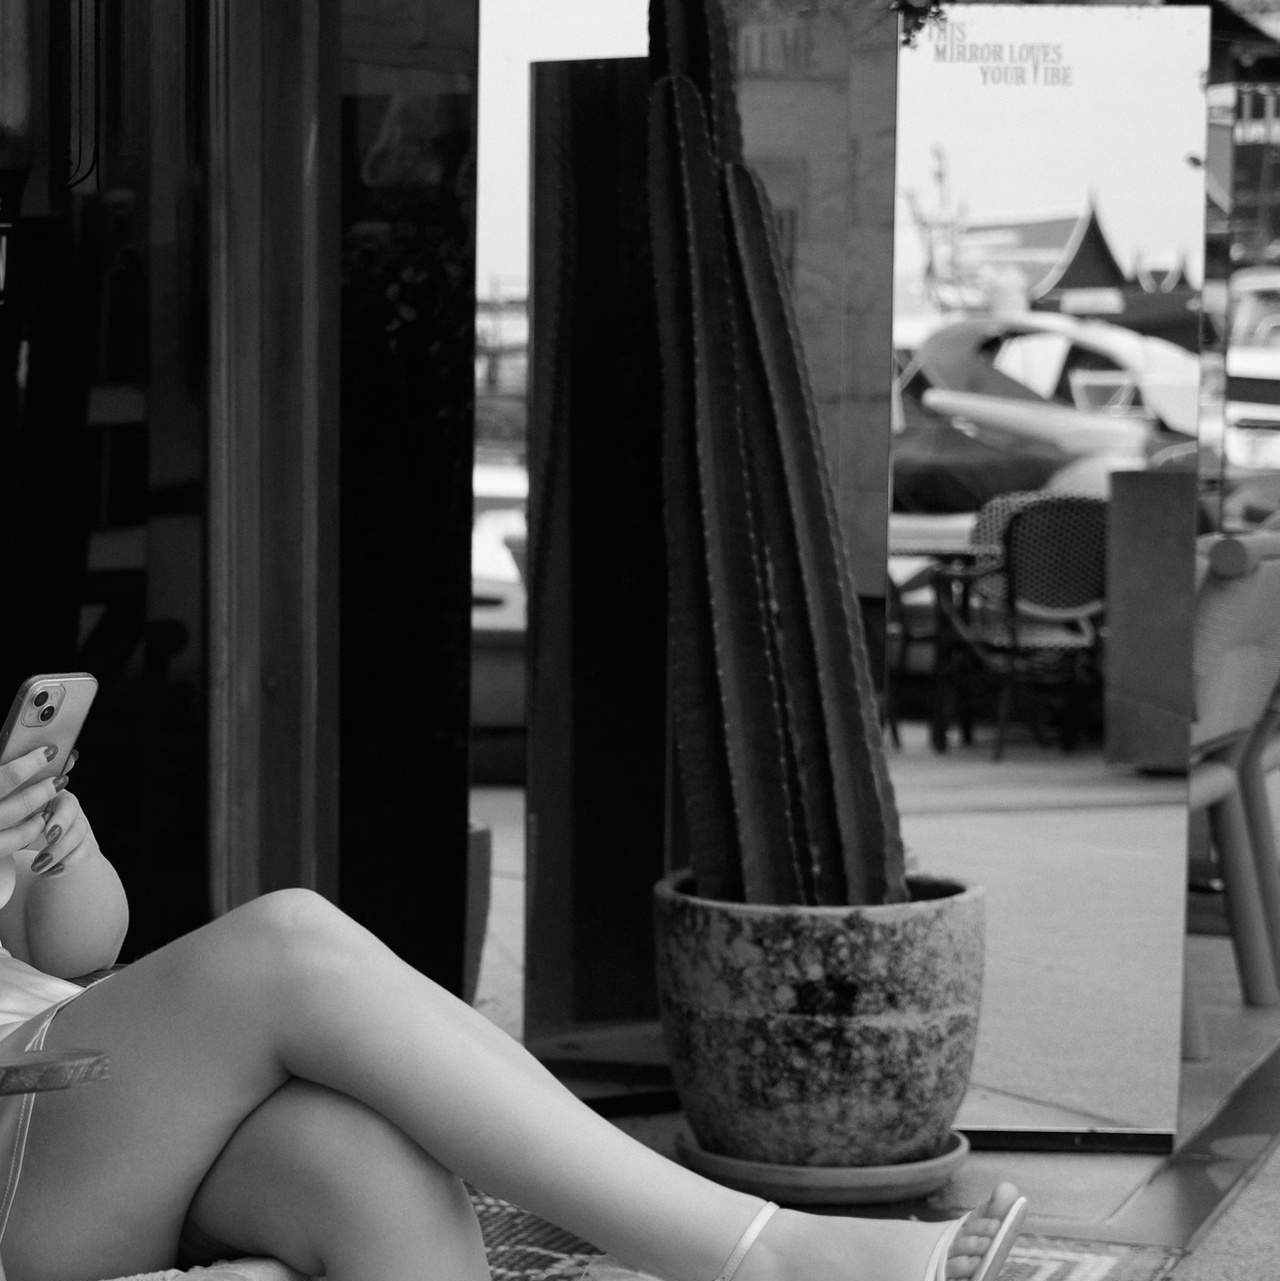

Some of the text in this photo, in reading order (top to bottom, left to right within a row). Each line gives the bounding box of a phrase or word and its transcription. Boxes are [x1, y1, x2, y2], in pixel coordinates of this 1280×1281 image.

[934, 43, 1063, 65] MIRROR LOVES
[979, 66, 1027, 87] YOUR
